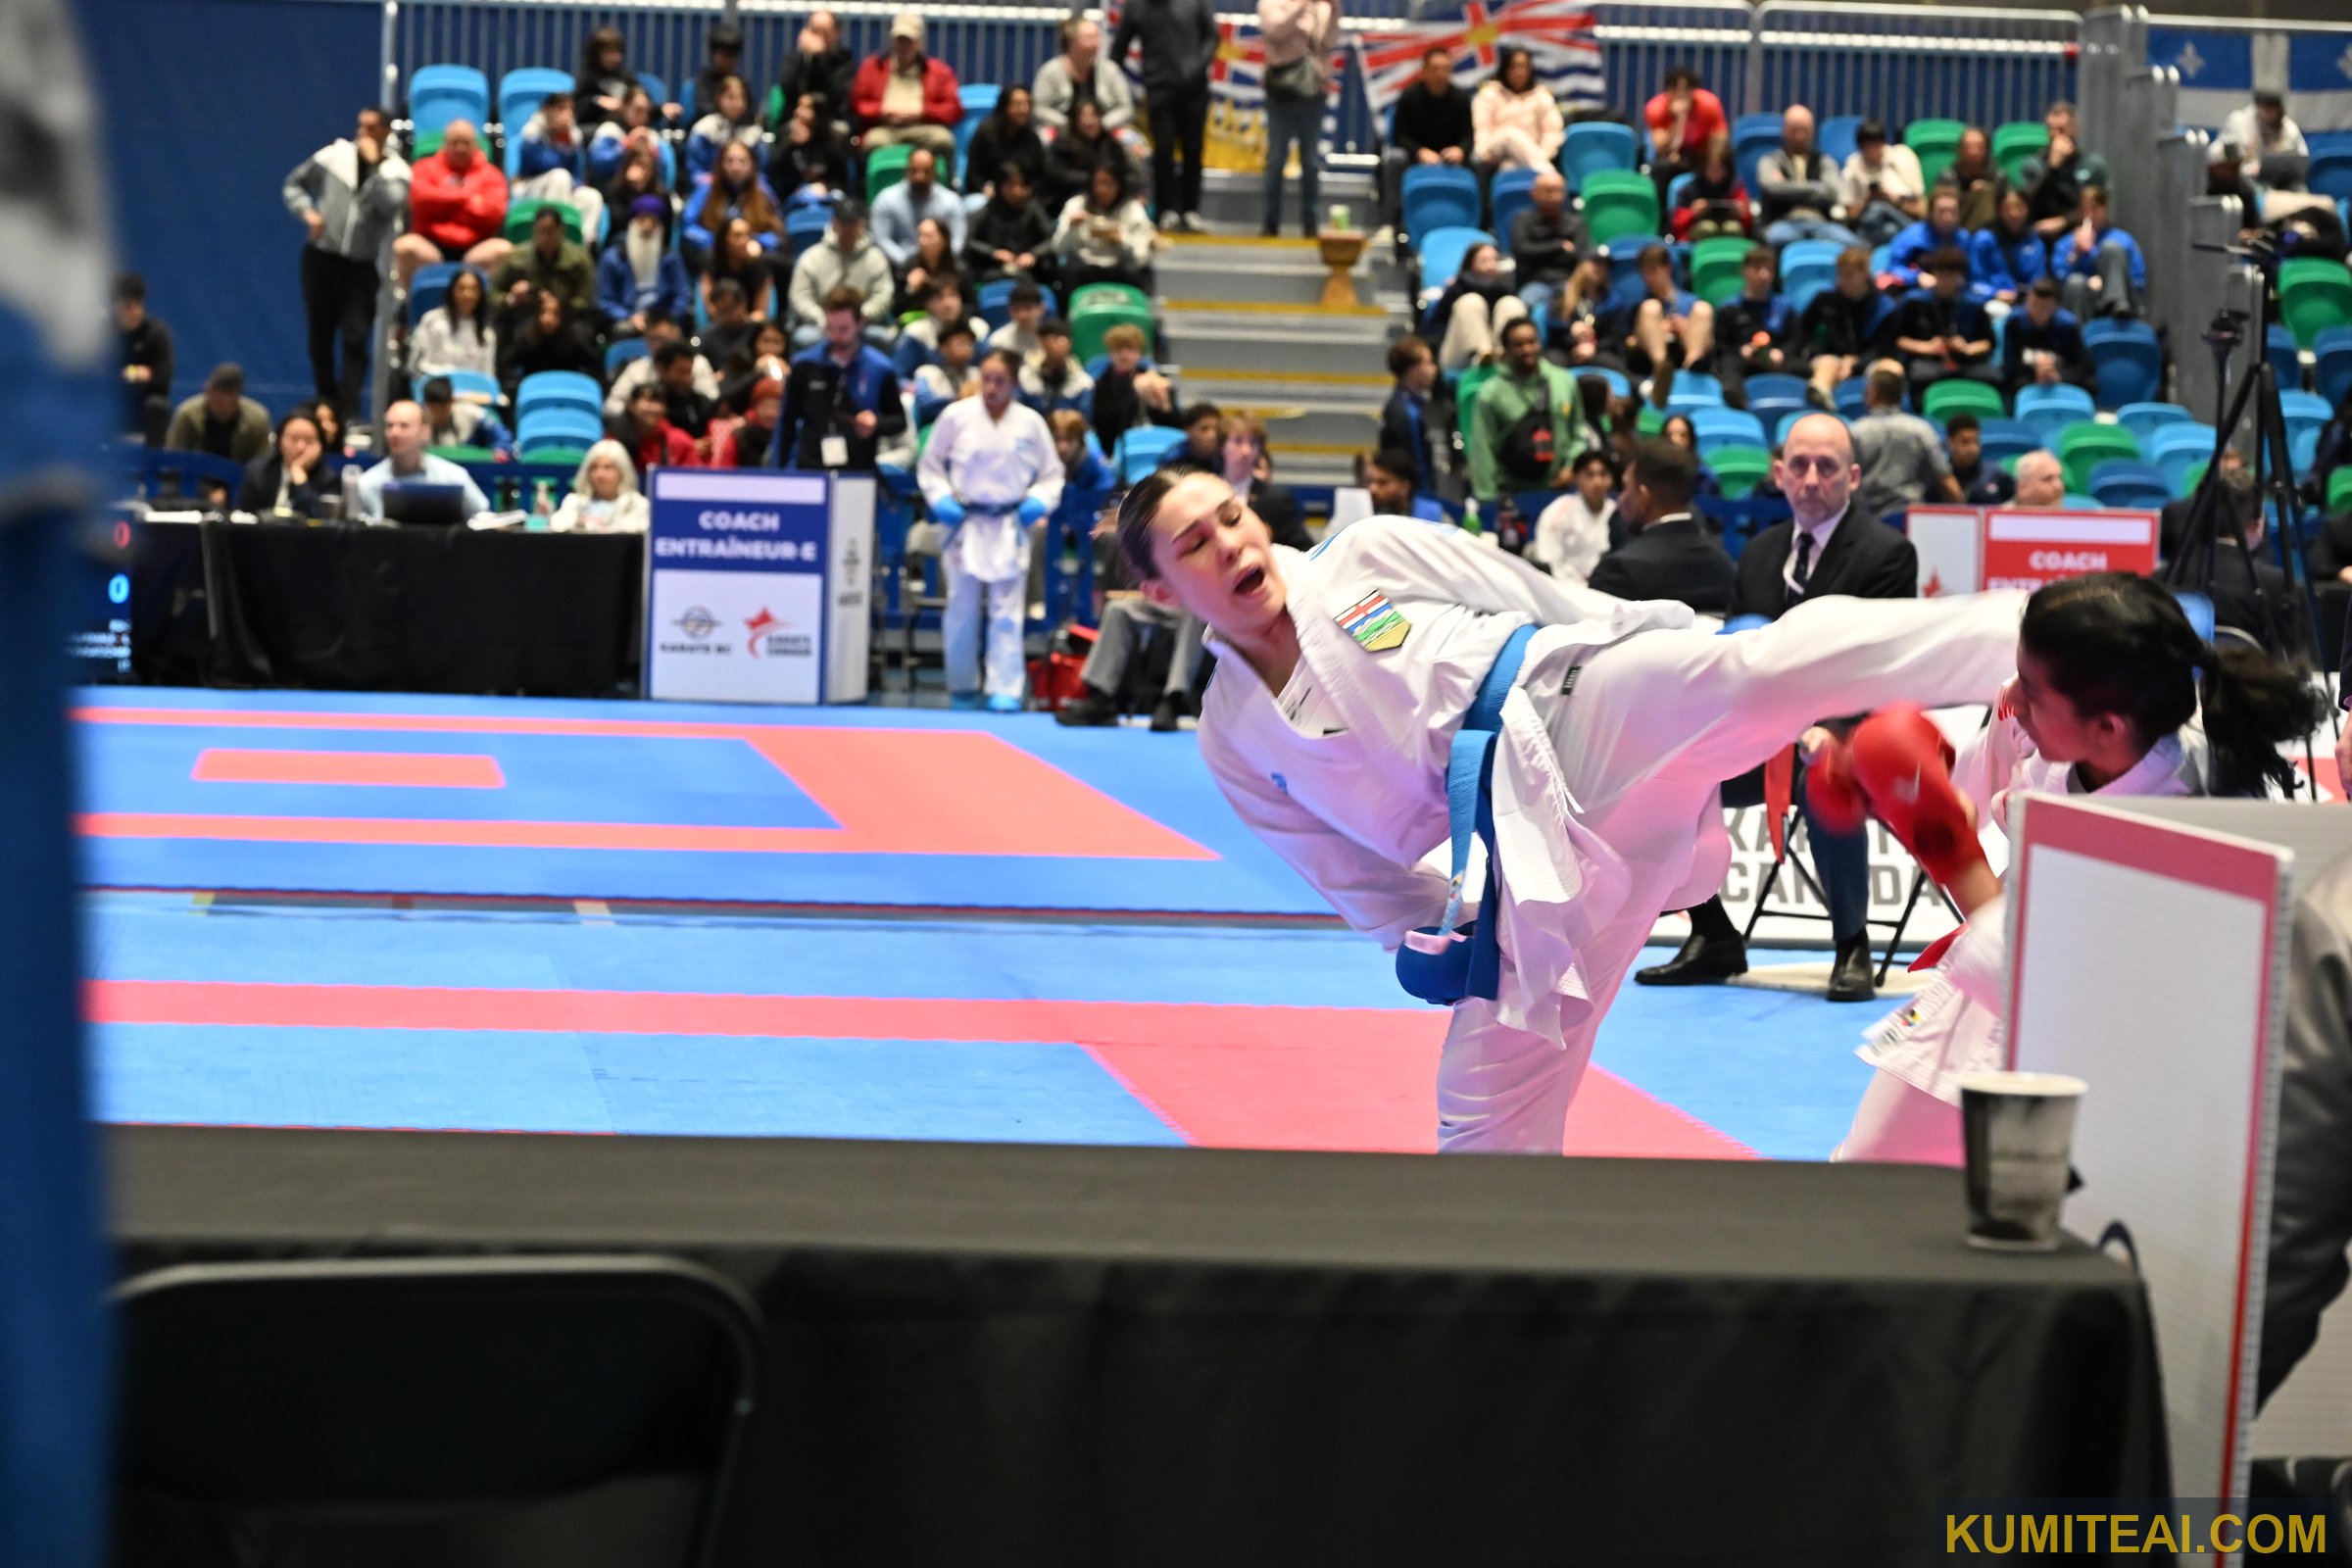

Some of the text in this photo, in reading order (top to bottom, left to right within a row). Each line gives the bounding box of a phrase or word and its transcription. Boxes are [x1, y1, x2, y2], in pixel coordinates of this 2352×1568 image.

[698, 510, 781, 532] COACH
[2029, 550, 2108, 571] COACH
[108, 572, 130, 604] 0
